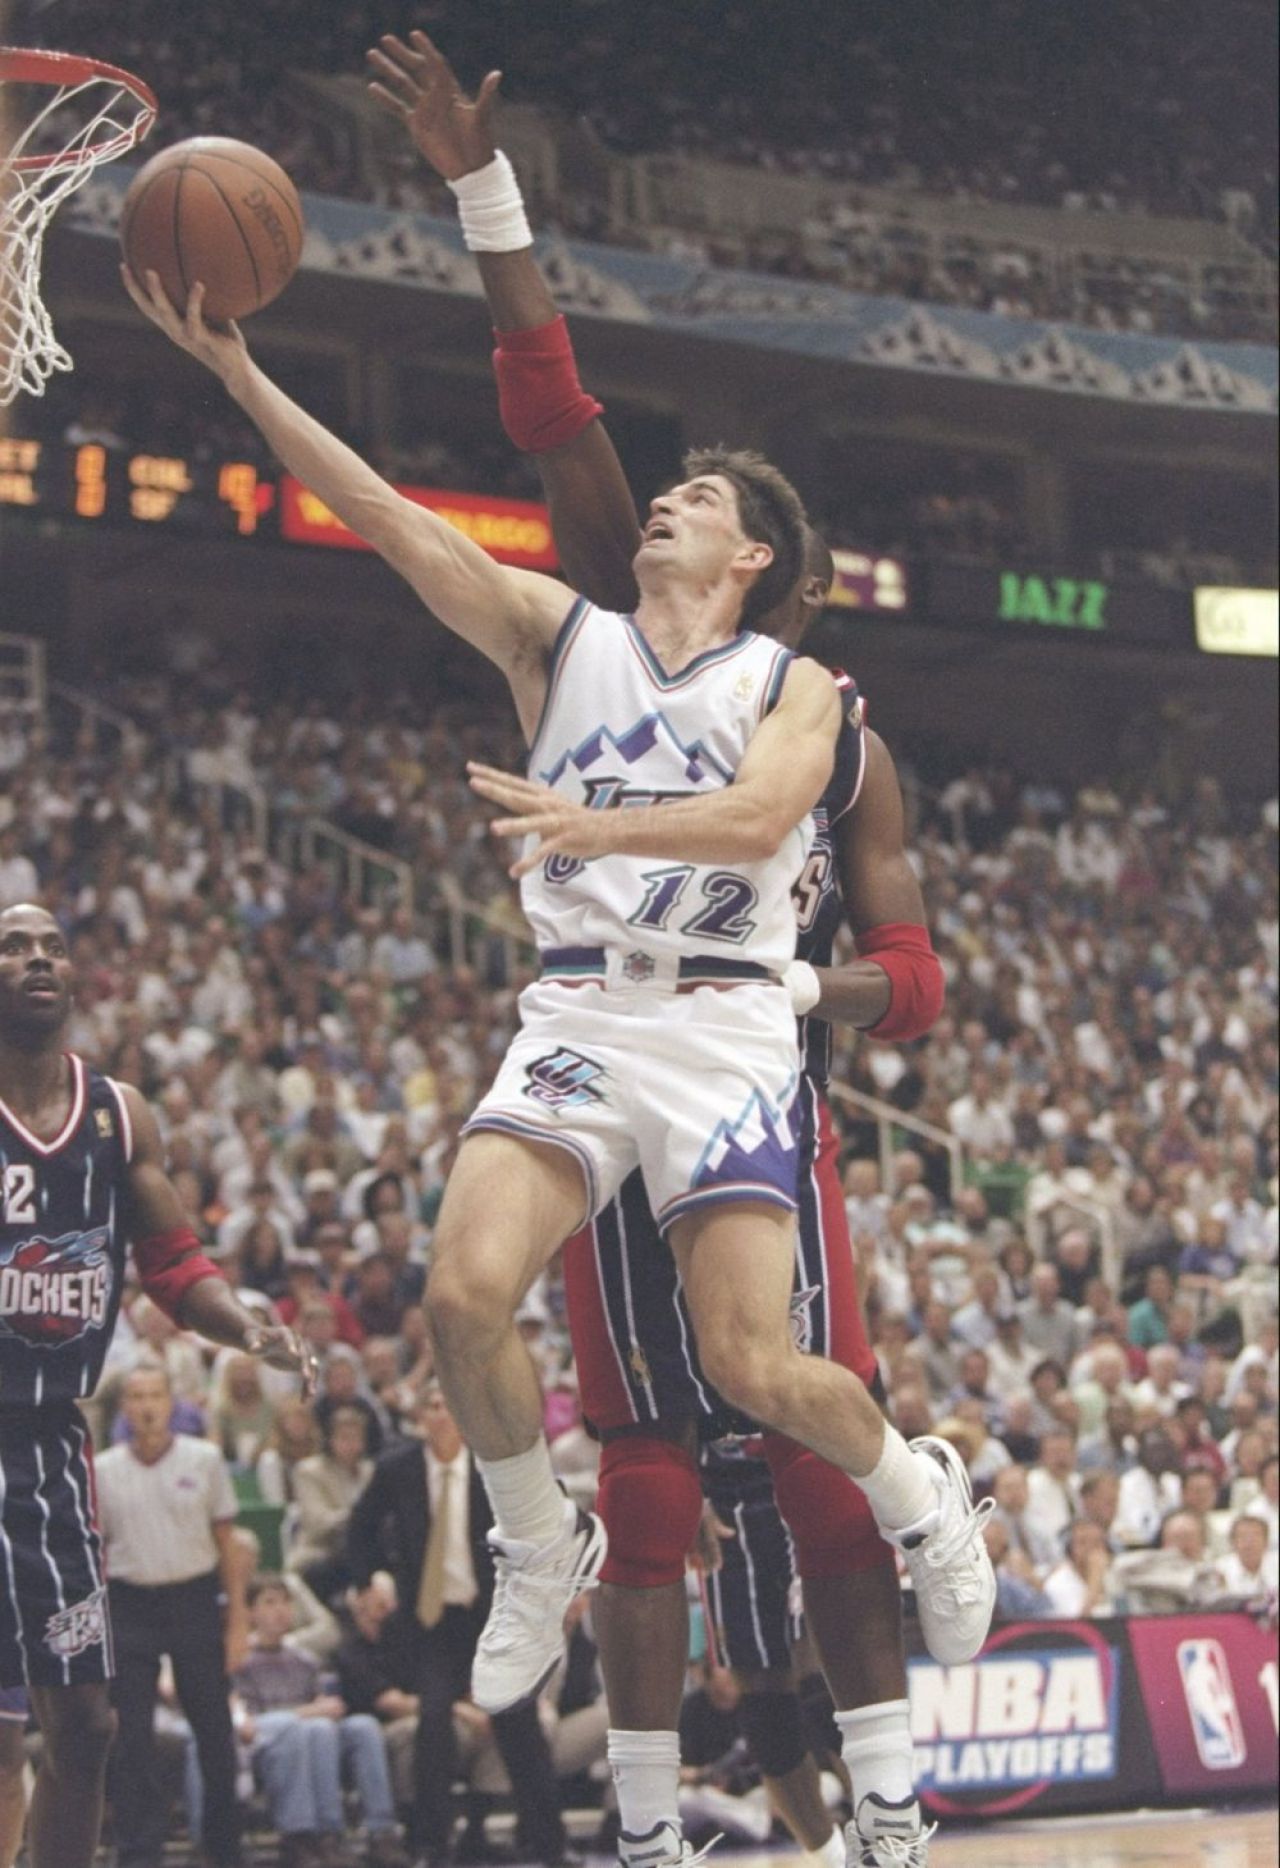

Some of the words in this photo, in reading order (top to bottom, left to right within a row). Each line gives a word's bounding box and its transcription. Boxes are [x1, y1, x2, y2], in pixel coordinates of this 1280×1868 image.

[999, 571, 1107, 629] JAZZ
[628, 866, 757, 945] 12
[0, 1164, 36, 1224] 2
[0, 1265, 107, 1323] OCKETS
[907, 1656, 1107, 1741] NBA
[912, 1734, 1112, 1784] PLAYOFFS
